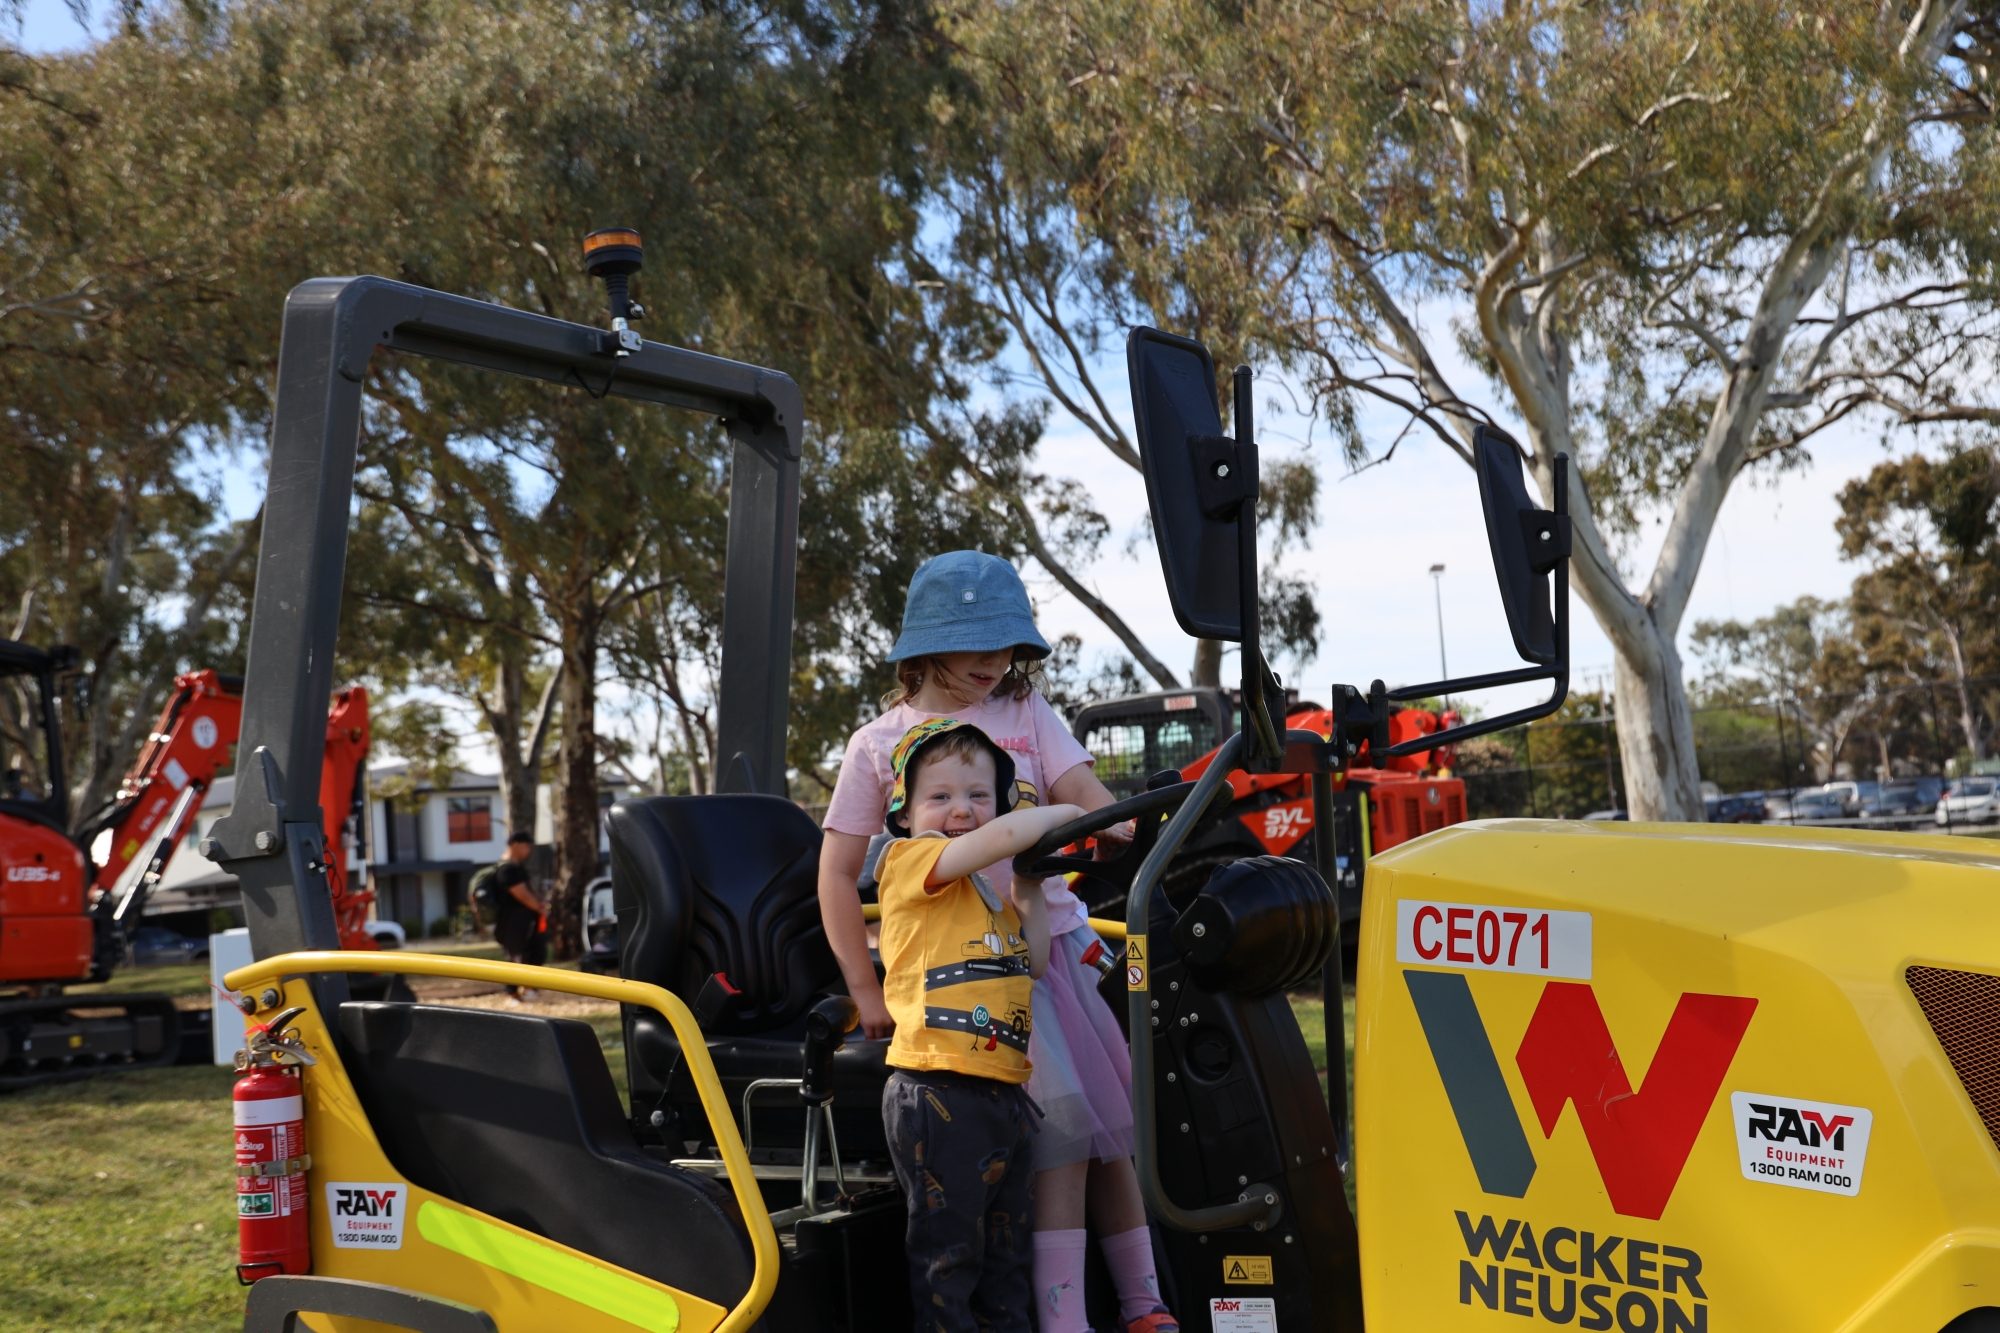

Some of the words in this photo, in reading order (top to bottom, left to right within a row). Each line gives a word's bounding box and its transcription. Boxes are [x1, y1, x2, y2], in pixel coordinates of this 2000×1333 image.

[1265, 807, 1311, 826] SVL
[1413, 905, 1549, 969] CE071
[976, 1009, 987, 1020] GO
[1748, 1103, 1854, 1151] RAM
[1766, 1146, 1845, 1169] EQUIPMENT
[1750, 1161, 1785, 1177] 1300
[1788, 1168, 1820, 1183] RAM
[1823, 1173, 1852, 1188] 000
[336, 1189, 397, 1217] RAM
[347, 1220, 393, 1231] EQUIPMENT
[338, 1233, 359, 1242] 1300
[360, 1234, 379, 1243] RAM
[380, 1235, 398, 1244] 000
[1454, 1209, 1709, 1300] WACKER
[1214, 1301, 1241, 1311] RAM
[1459, 1259, 1708, 1333] NEUSON
